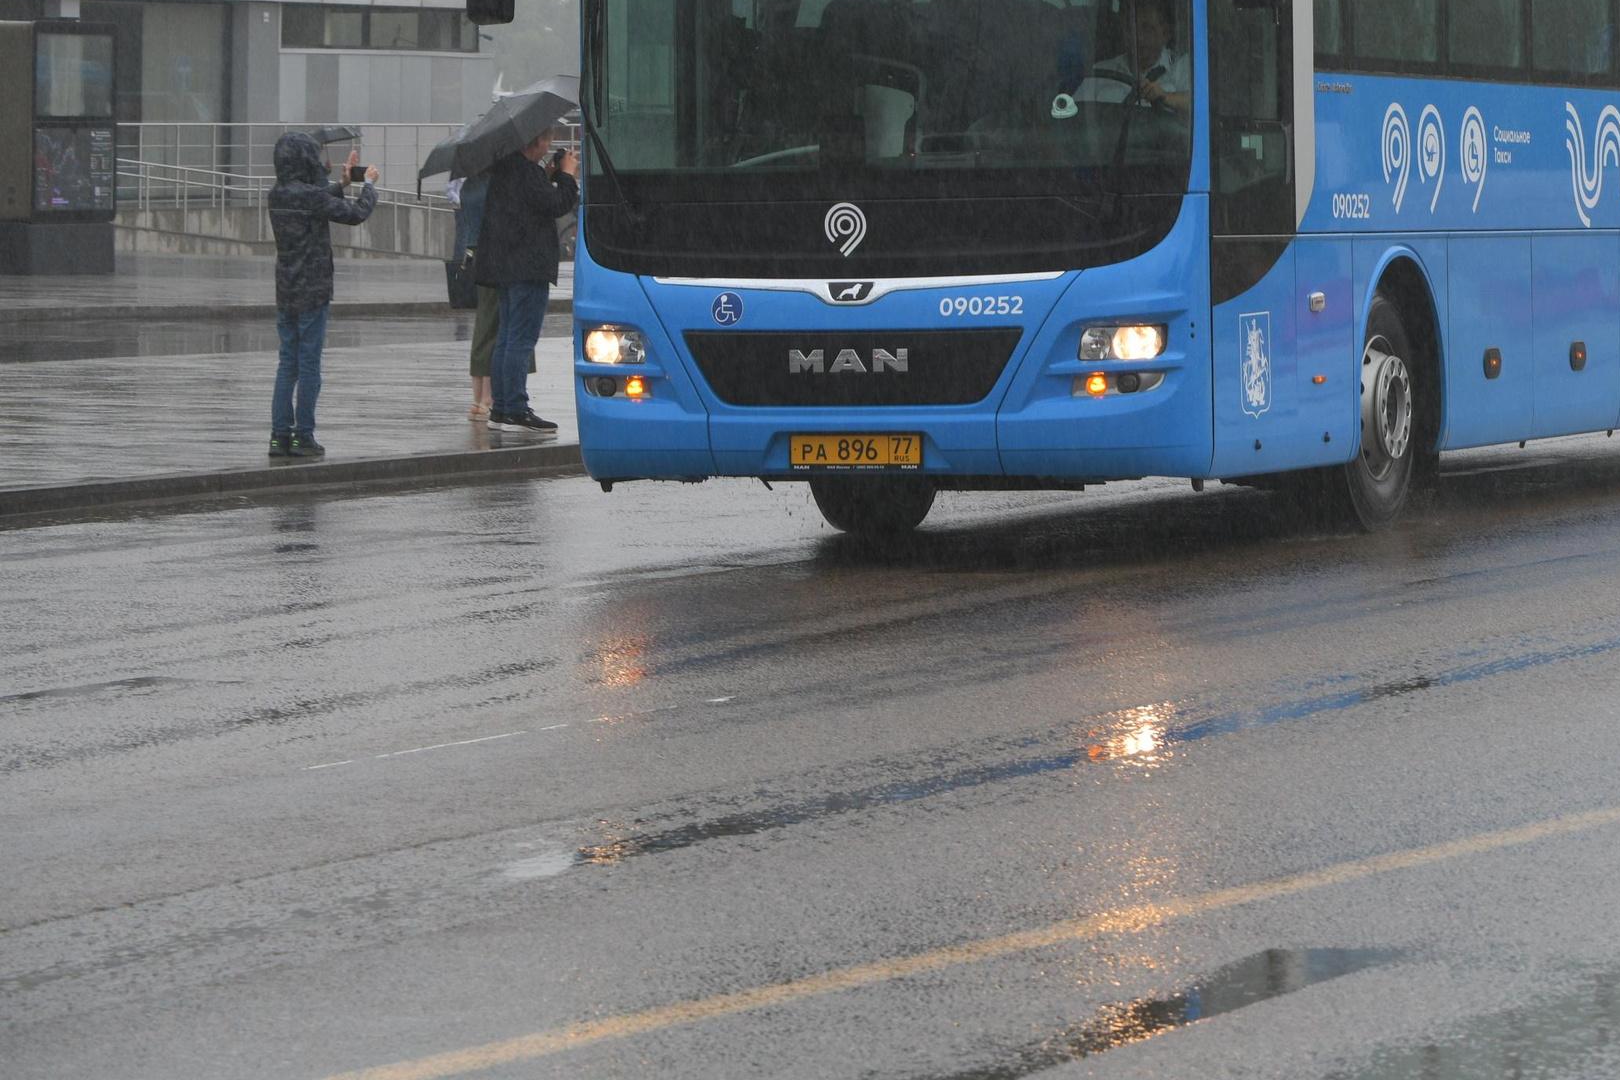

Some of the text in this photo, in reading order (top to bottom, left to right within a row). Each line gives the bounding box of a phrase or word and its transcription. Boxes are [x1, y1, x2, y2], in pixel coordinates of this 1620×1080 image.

[1493, 125, 1532, 145] Социальное
[1493, 147, 1512, 164] Такси
[1332, 193, 1370, 219] 090252
[939, 296, 1024, 316] 090252
[789, 348, 909, 373] MAN
[837, 439, 878, 461] 896
[891, 437, 912, 454] 77
[893, 454, 910, 462] RUS
